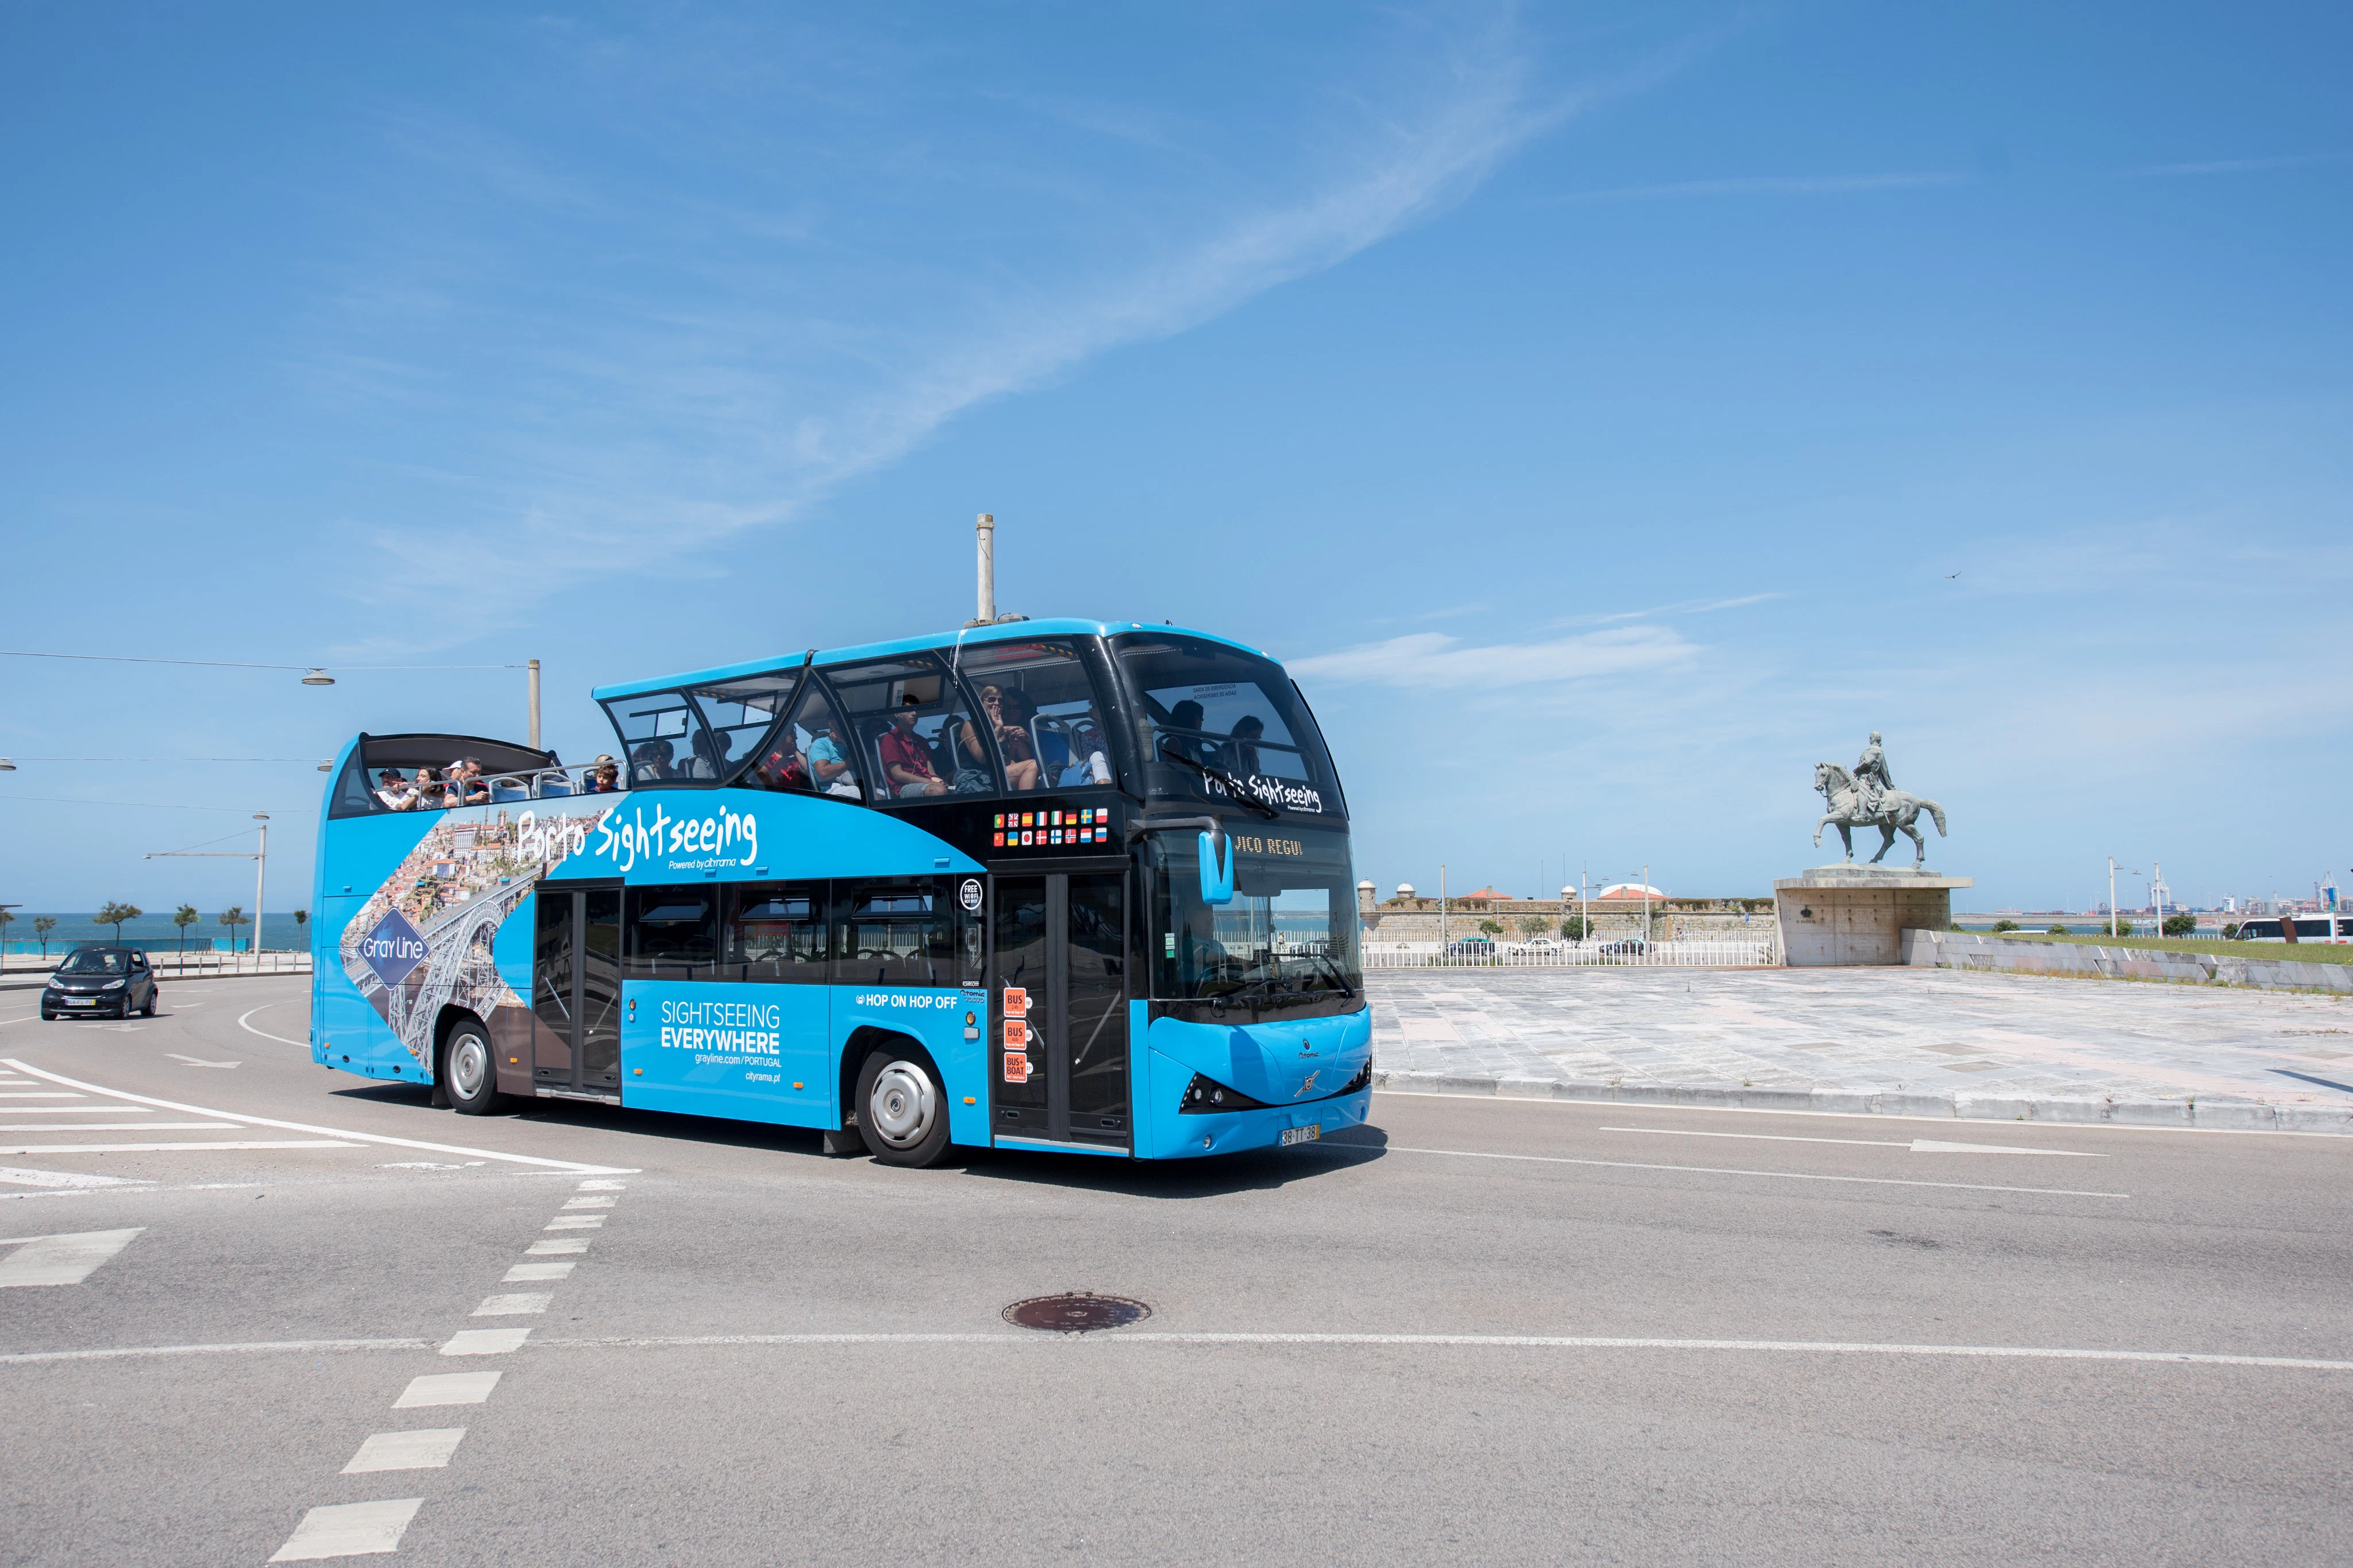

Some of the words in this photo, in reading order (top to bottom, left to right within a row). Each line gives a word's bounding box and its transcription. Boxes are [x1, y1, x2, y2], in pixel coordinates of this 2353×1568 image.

[518, 810, 585, 862] Porto
[595, 803, 758, 872] Sightseeing
[669, 859, 696, 870] Powered
[696, 859, 704, 870] by
[704, 858, 736, 867] cityrama
[866, 994, 889, 1006] HOP
[890, 994, 907, 1007] ON
[909, 995, 933, 1008] HOP
[935, 997, 958, 1009] OFF
[1008, 995, 1023, 1004] BUS
[662, 1001, 780, 1029] SIGHTSEEING
[1008, 1027, 1023, 1036] BUS
[661, 1026, 780, 1055] EVERYWHERE
[746, 1071, 781, 1084] cityrama.pt
[1007, 1067, 1024, 1075] BOAT
